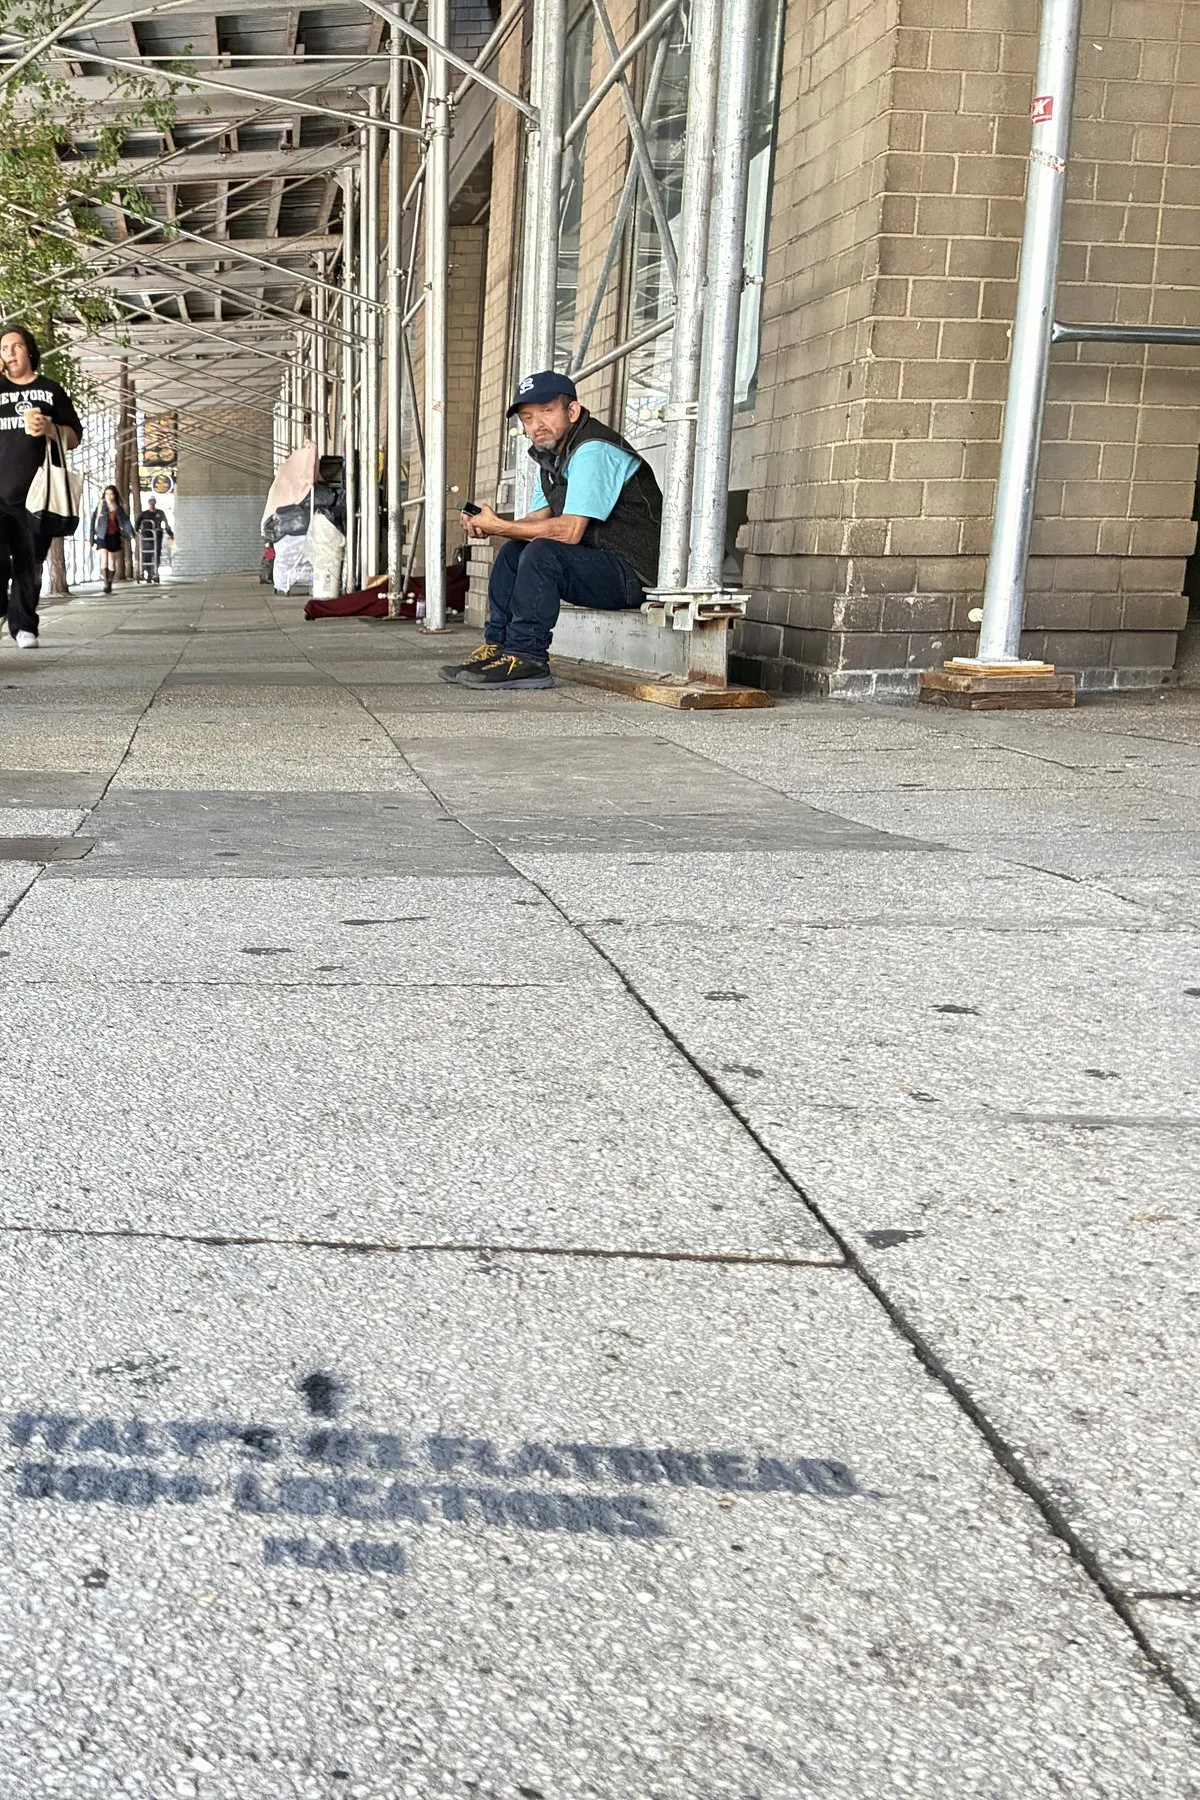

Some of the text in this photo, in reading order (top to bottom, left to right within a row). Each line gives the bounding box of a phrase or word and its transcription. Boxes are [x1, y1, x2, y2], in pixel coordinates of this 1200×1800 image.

[20, 389, 54, 406] YORK
[428, 1435, 860, 1500] FLATBREAD
[234, 1472, 668, 1538] LOCATIONS
